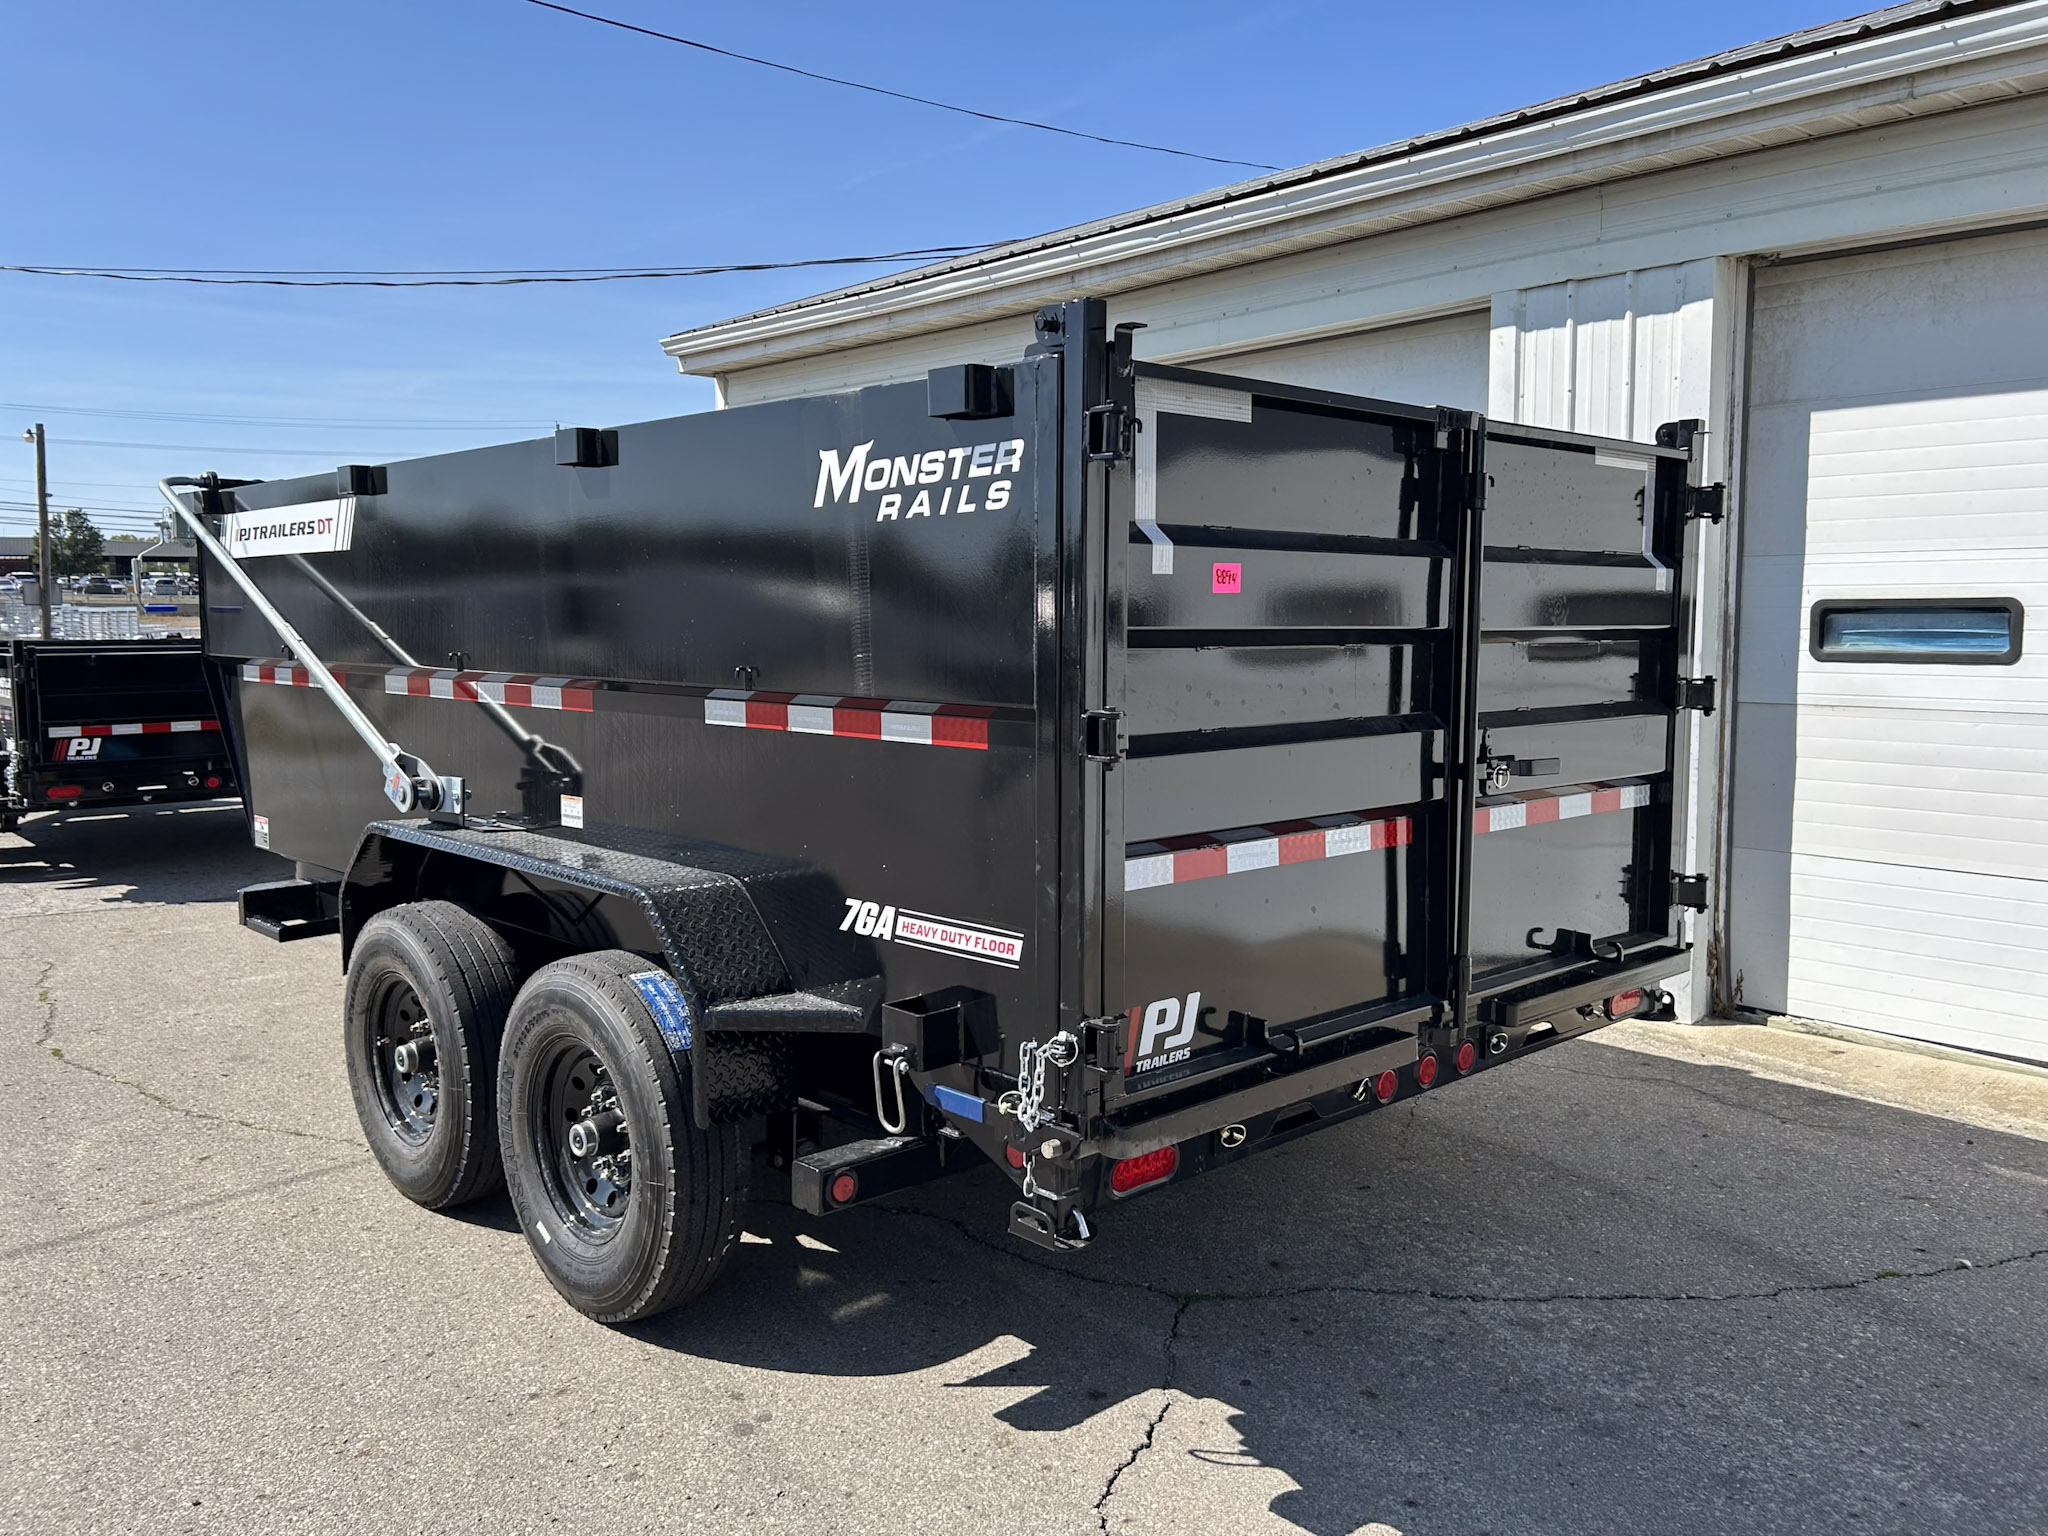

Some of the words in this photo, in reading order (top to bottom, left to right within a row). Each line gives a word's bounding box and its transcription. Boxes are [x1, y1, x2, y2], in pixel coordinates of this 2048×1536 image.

[876, 480, 1012, 522] RAILS
[253, 521, 316, 541] TRAILERS
[317, 518, 334, 535] DT
[67, 737, 102, 756] PJ
[839, 897, 896, 941] 7GA
[901, 921, 939, 940] HEAVY
[940, 928, 972, 947] DUTY
[973, 936, 1015, 956] FLOOR
[1138, 991, 1201, 1057] PJ
[1135, 1047, 1191, 1073] TRAILERS
